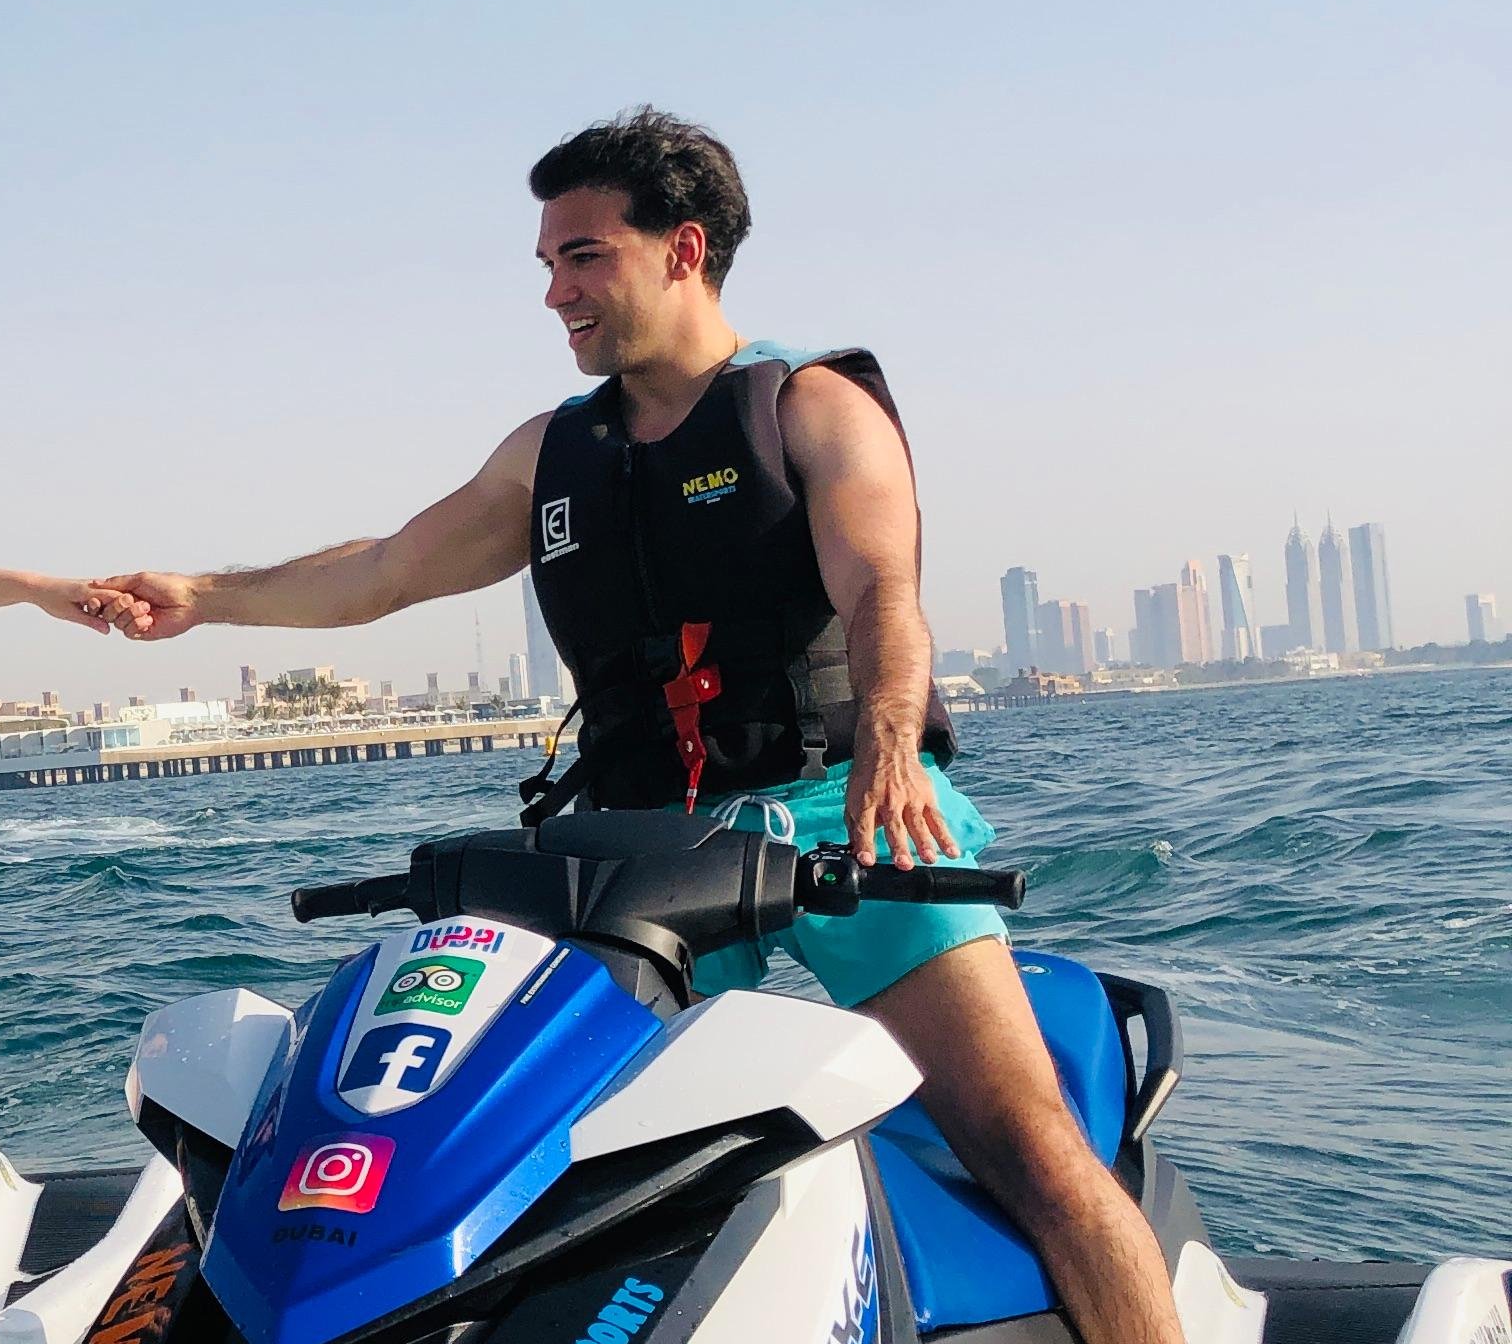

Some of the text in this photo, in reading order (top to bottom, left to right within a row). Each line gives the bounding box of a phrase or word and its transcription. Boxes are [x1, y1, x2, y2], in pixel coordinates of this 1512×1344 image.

[682, 467, 739, 496] NEMO
[402, 991, 463, 1010] advisor
[274, 1223, 358, 1248] DUBAI
